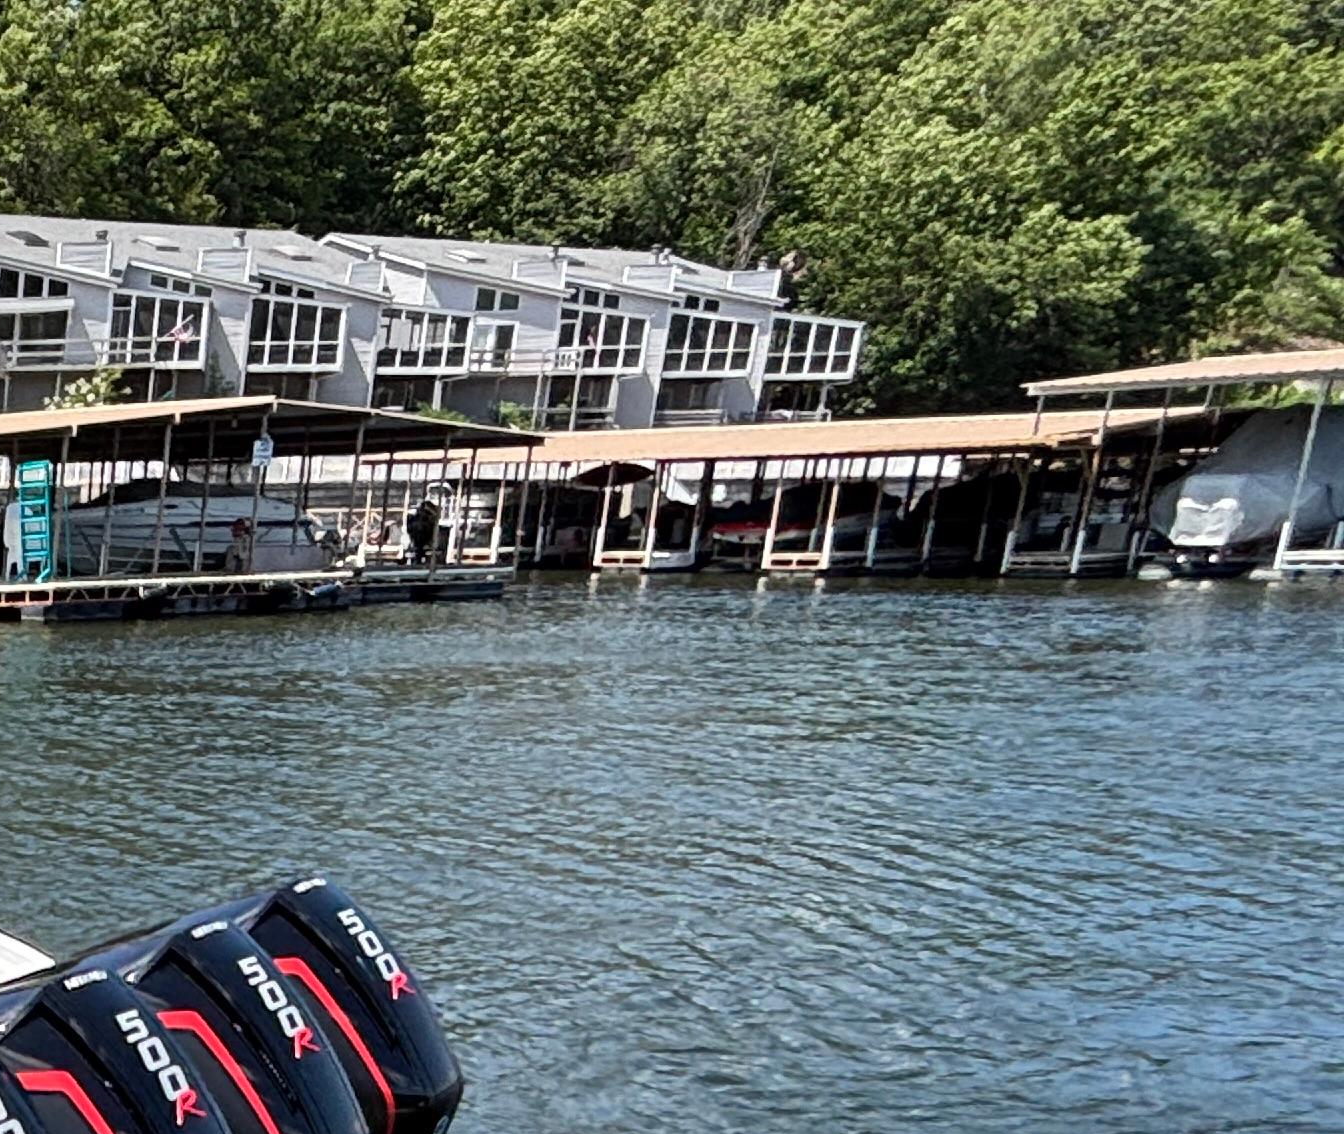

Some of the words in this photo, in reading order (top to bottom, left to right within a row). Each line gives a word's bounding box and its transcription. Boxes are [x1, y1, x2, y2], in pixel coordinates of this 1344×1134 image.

[337, 908, 416, 1000] 500R
[237, 956, 321, 1059] 500R
[115, 1009, 208, 1126] 500R
